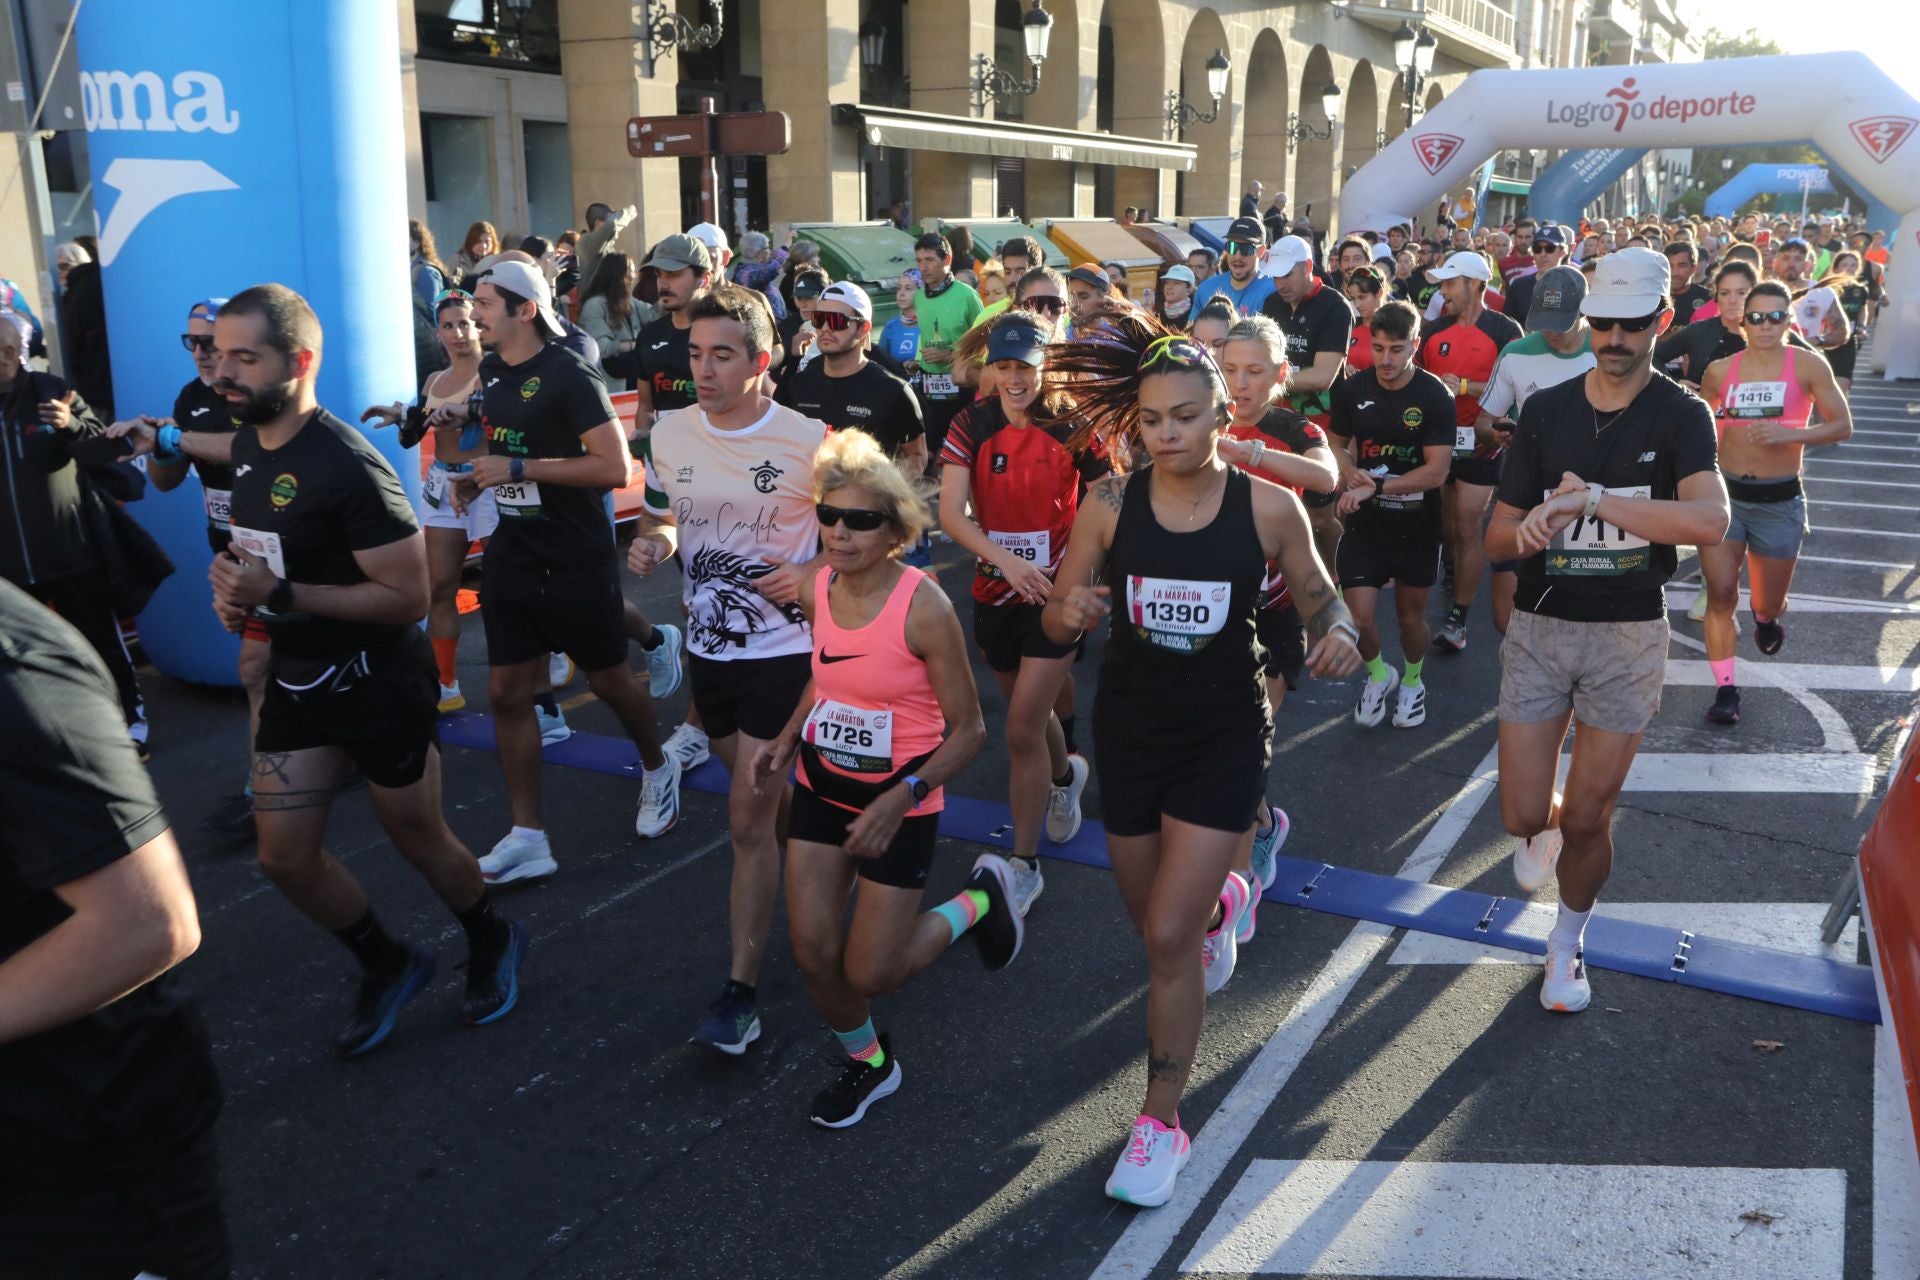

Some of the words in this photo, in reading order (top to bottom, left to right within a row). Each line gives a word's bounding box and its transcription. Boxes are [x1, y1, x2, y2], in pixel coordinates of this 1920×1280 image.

[1649, 91, 1756, 123] deporte
[1776, 168, 1829, 180] POWER
[1799, 180, 1827, 190] RDE
[654, 371, 696, 392] ferre
[930, 382, 951, 390] 1815
[1738, 392, 1773, 402] 1416
[1361, 440, 1415, 459] ferrer
[210, 502, 230, 515] 129
[716, 502, 782, 544] Candela
[1005, 547, 1036, 561] 89
[1153, 589, 1163, 600] LA
[1164, 590, 1202, 602] MARATÓN
[1145, 602, 1210, 624] 1390
[836, 712, 865, 728] MARATÓN
[818, 720, 873, 748] 1726
[835, 743, 853, 752] LUCY
